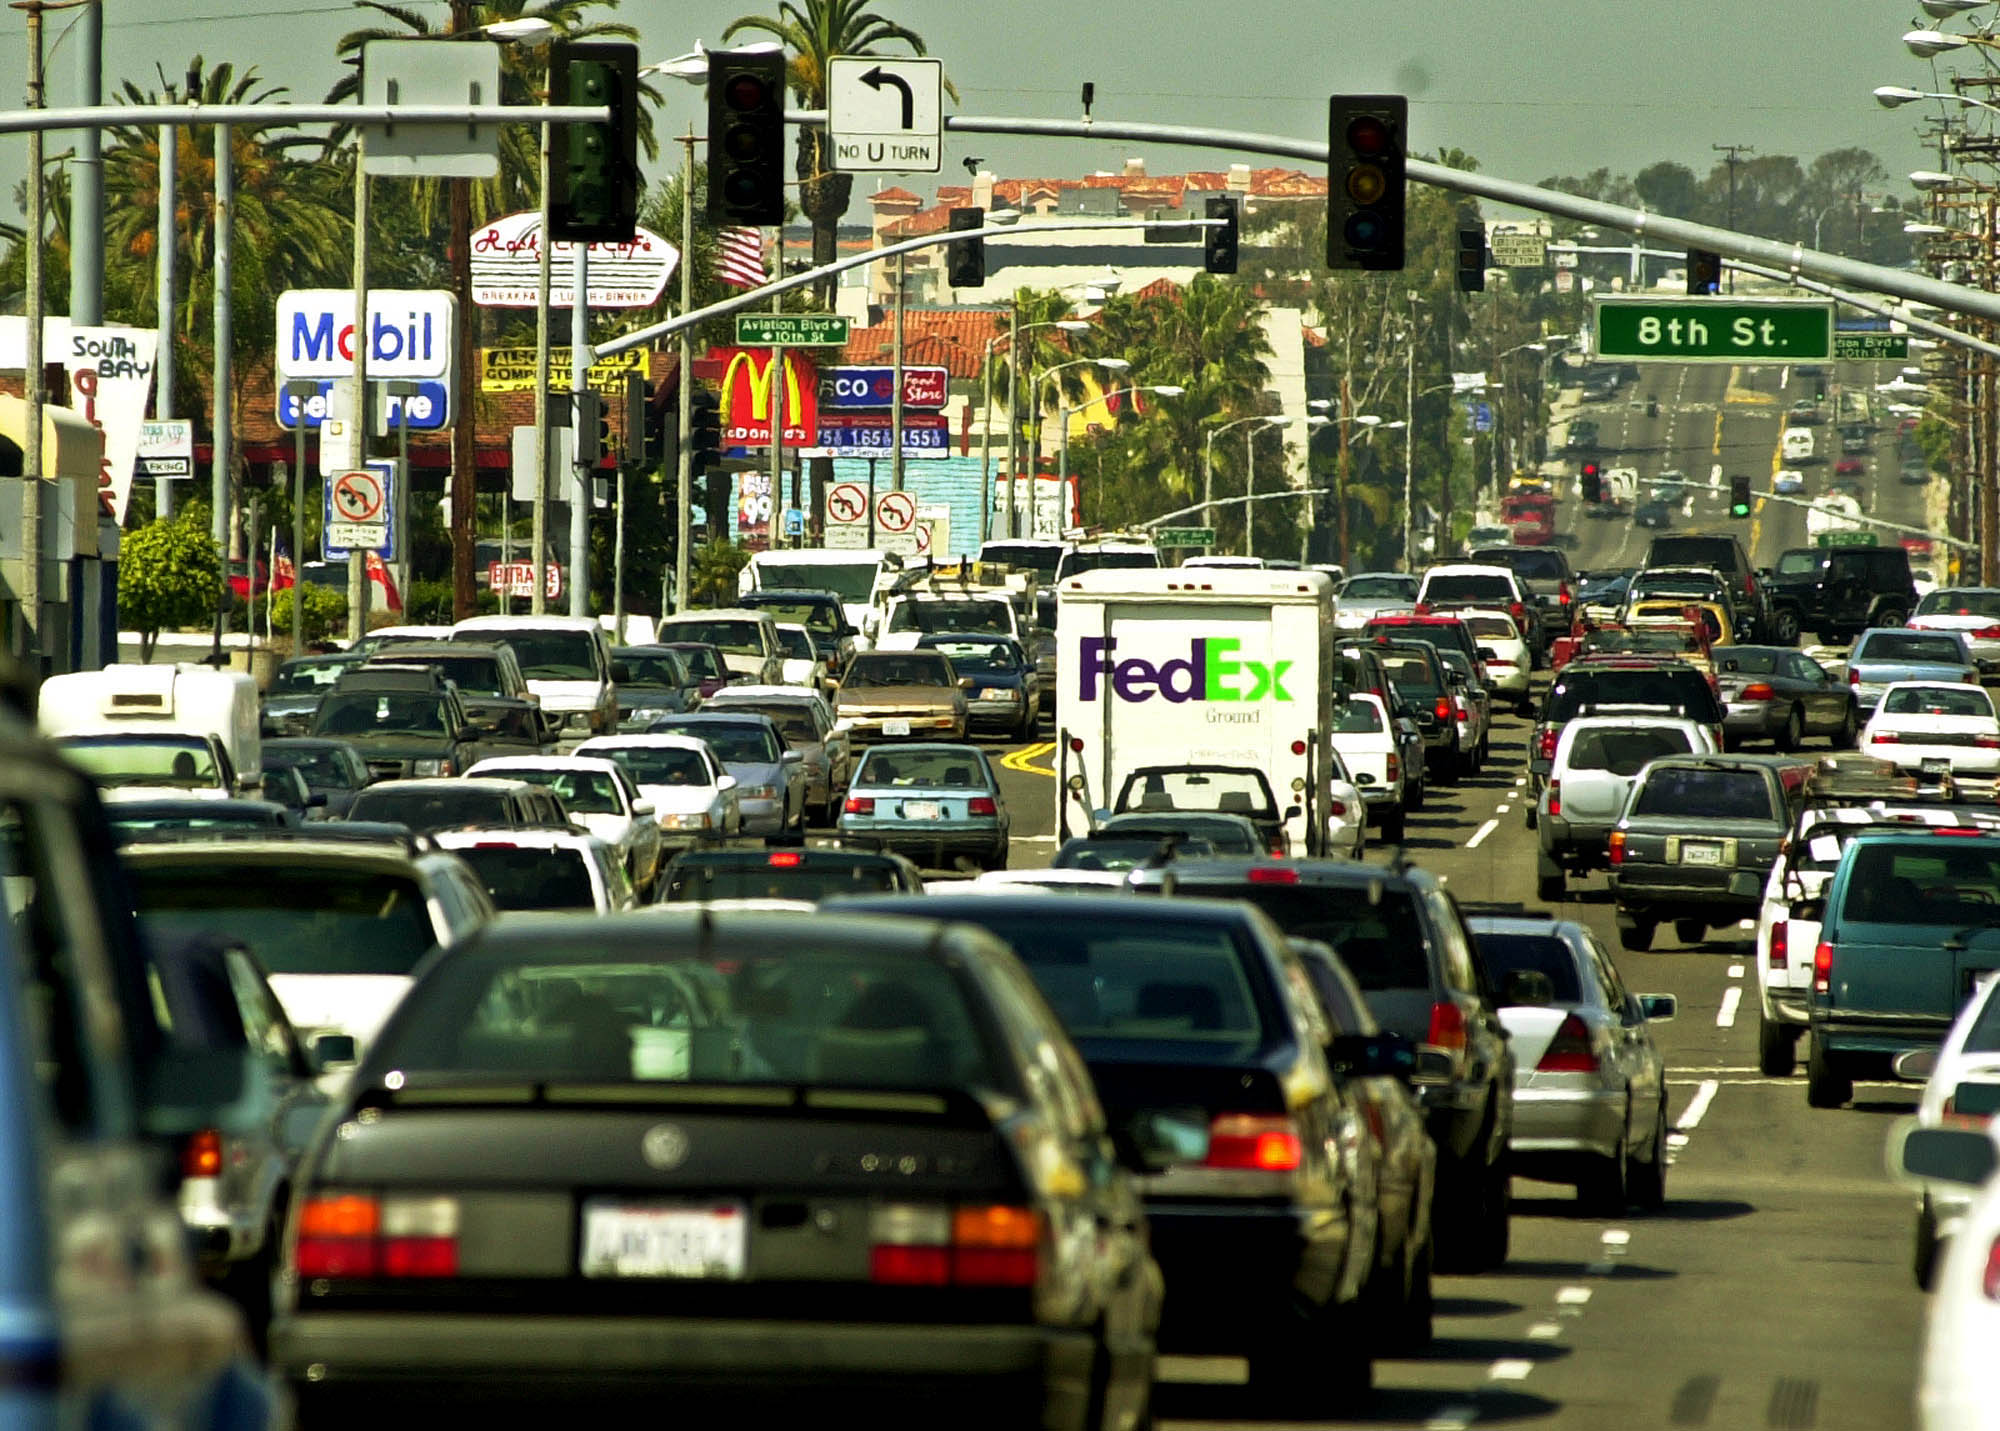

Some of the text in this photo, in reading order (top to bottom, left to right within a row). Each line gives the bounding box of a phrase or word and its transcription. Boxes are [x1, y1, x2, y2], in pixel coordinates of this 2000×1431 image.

[838, 142, 930, 163] NO U TURN
[560, 292, 597, 302] LUH
[742, 319, 830, 331] Aviation Blvd
[1638, 316, 1789, 347] 8th St.
[292, 312, 432, 362] Mobil
[775, 331, 825, 343] 10th St
[73, 336, 136, 359] SOUTH
[98, 360, 150, 380] BAY
[1079, 636, 1295, 704] FedEx
[1205, 707, 1261, 724] Ground
